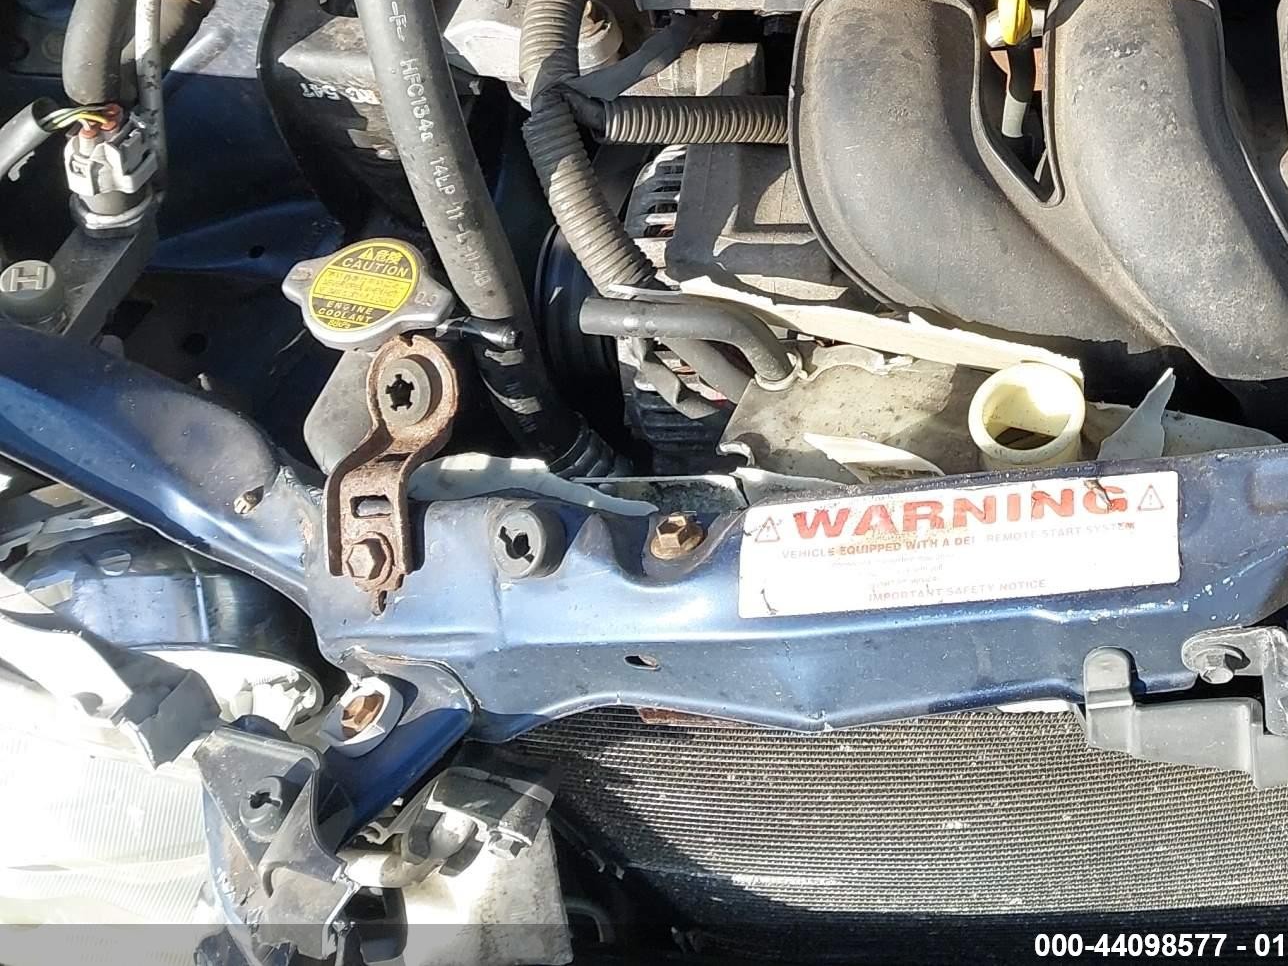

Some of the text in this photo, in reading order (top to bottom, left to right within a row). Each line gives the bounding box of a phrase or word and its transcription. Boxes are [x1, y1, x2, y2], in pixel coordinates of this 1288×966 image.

[9, 265, 48, 292] H
[342, 257, 409, 278] CAUTION
[318, 308, 374, 323] COOLANT
[326, 300, 374, 316] ENGINE
[793, 484, 1129, 540] WARNING
[782, 547, 836, 559] VEHICLE
[839, 542, 902, 556] EQUIPPED
[905, 536, 938, 550] WITH
[942, 537, 950, 547] A
[1042, 526, 1082, 538] START
[868, 579, 1047, 602] IMPORTANT SAFETY NOTICE
